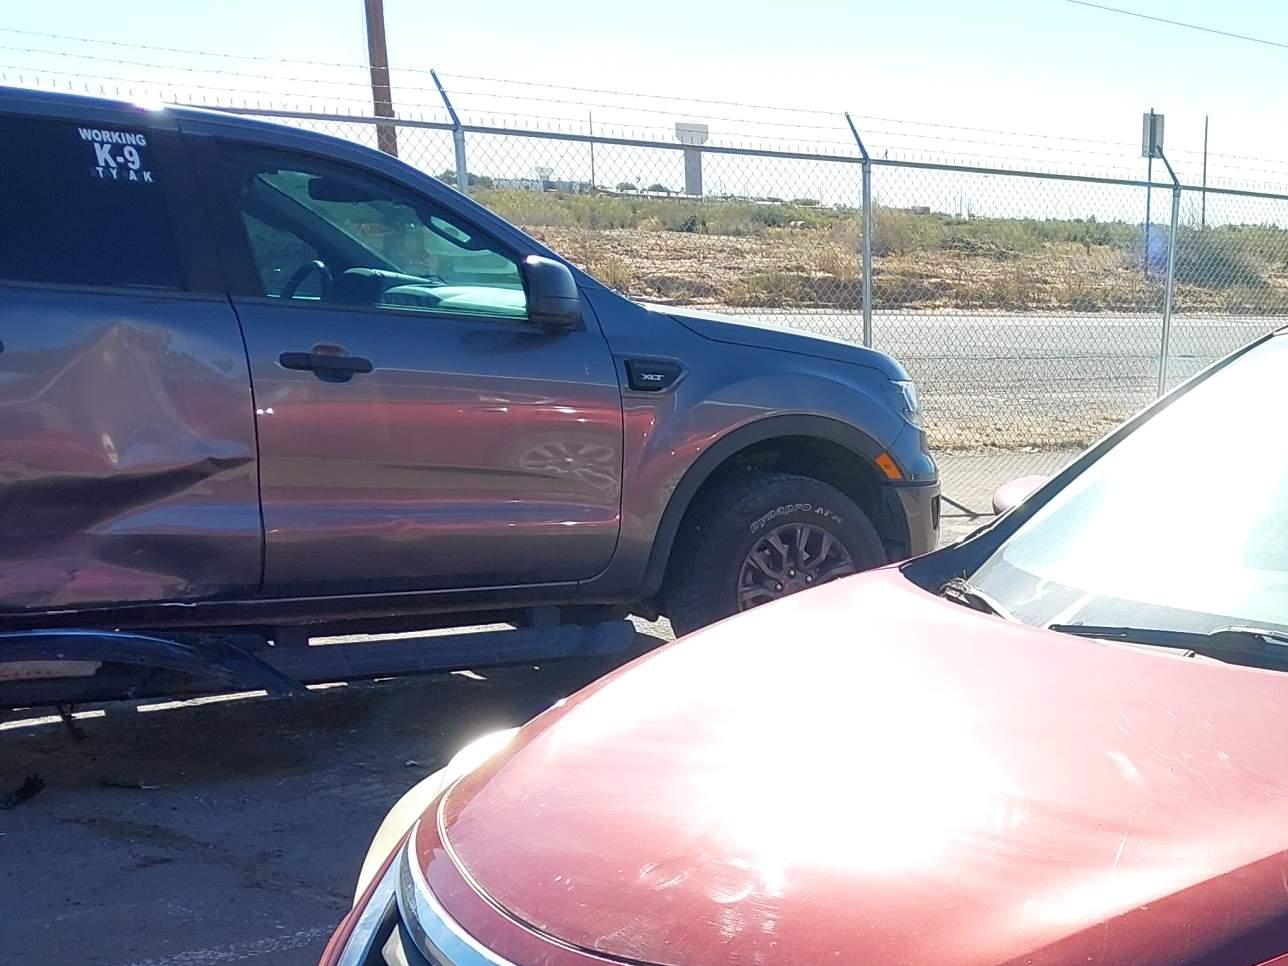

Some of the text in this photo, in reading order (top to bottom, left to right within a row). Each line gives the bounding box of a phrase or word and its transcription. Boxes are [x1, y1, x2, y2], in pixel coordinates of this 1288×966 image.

[78, 127, 147, 146] WORKING
[93, 142, 141, 170] K-9
[640, 372, 665, 381] XLT
